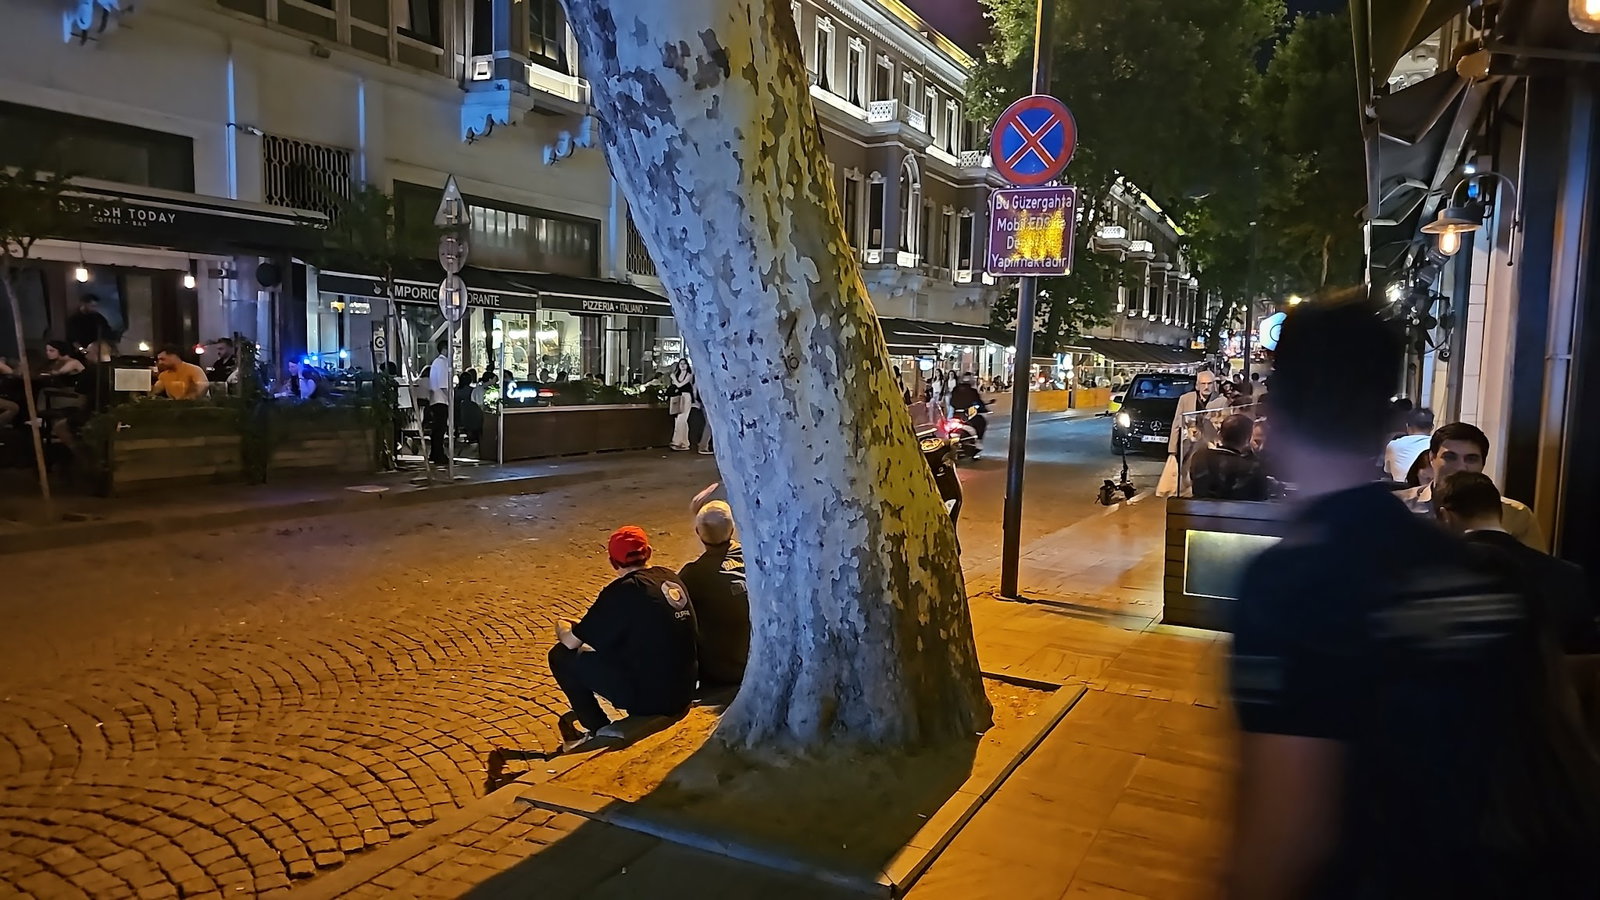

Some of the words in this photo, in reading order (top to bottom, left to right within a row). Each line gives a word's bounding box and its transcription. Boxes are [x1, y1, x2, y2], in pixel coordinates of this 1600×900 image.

[996, 194, 1009, 210] Bu
[1012, 194, 1072, 212] Güzergahta
[128, 208, 176, 224] TODAY
[582, 300, 615, 312] PIZZERIA
[620, 303, 644, 314] ITALIANO
